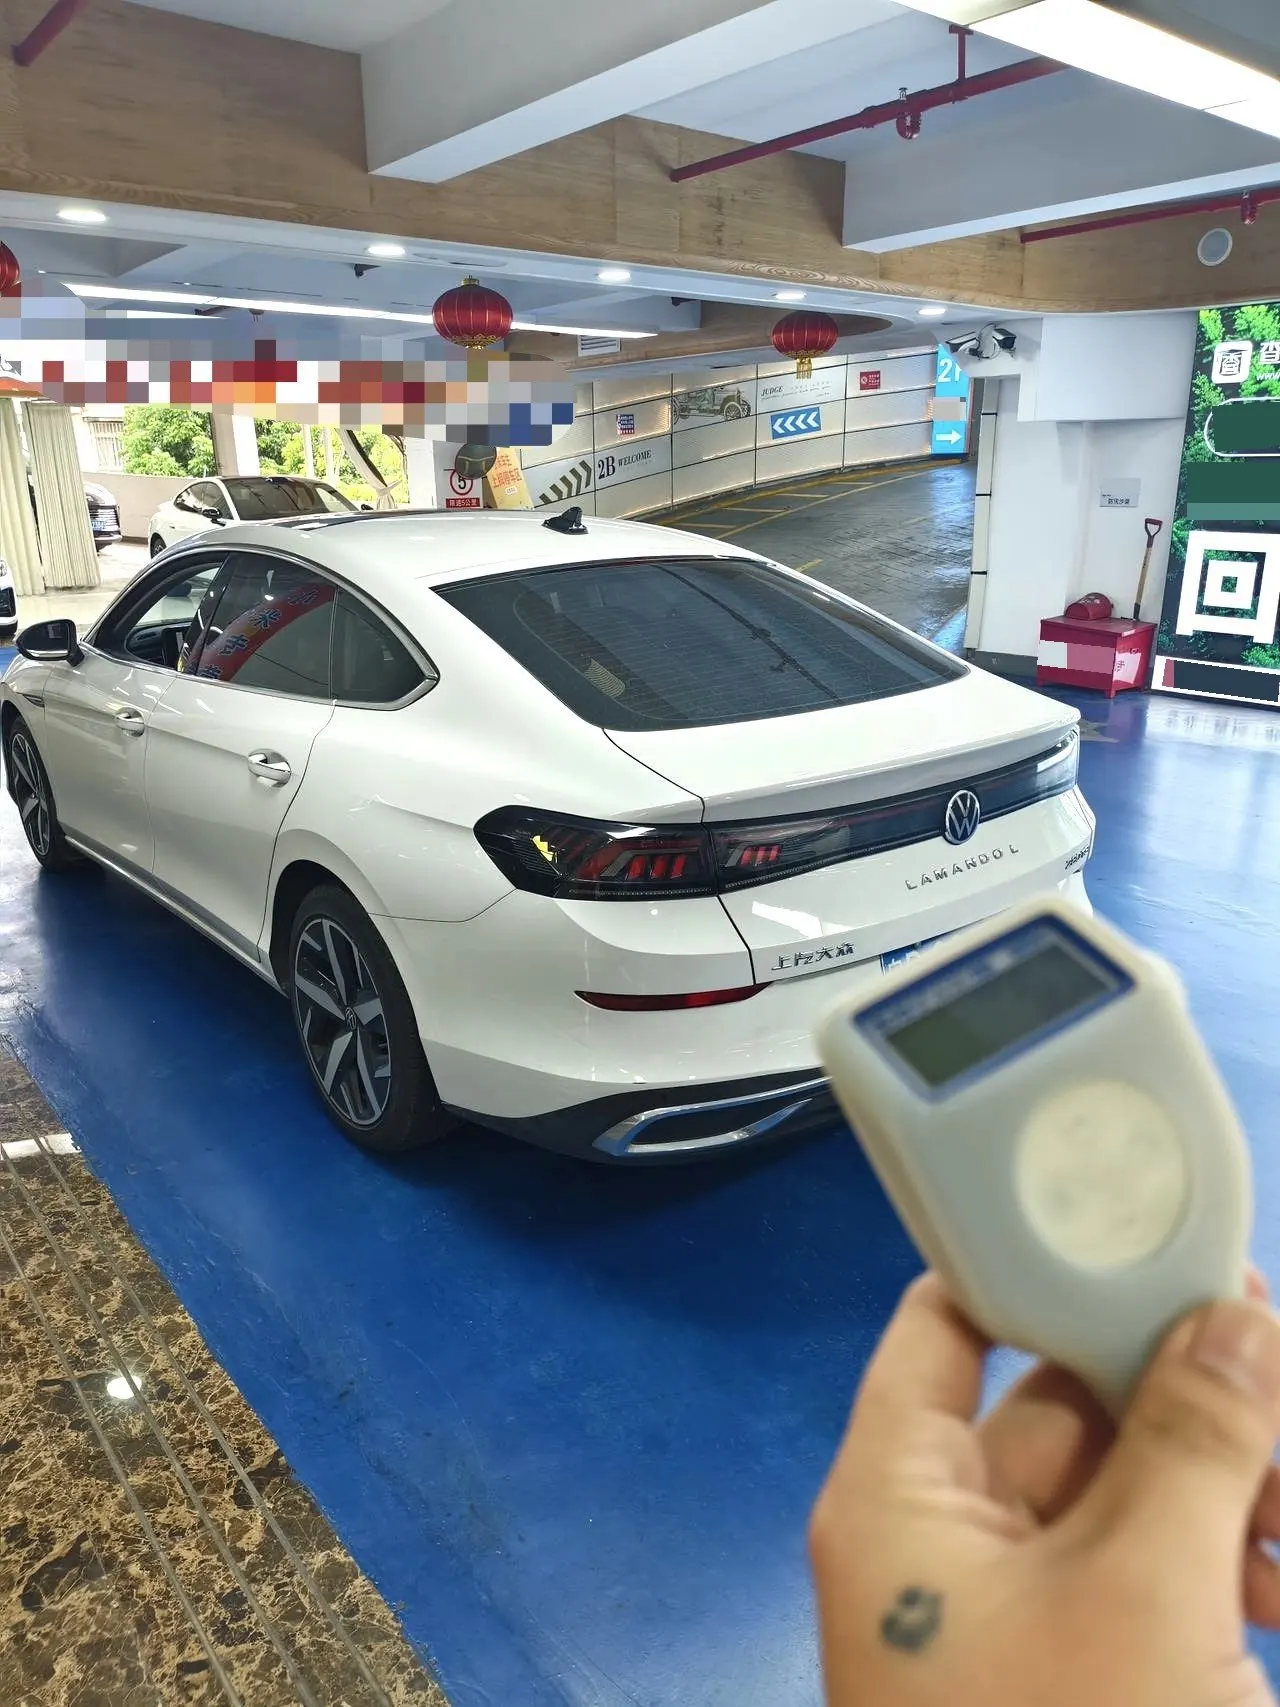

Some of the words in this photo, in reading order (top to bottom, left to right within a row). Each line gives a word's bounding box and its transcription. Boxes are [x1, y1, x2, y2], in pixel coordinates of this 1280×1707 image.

[598, 455, 616, 480] 2B
[617, 449, 652, 468] WELCOME
[457, 475, 466, 490] 5
[905, 848, 1003, 890] LAMANDO
[1008, 844, 1019, 854] L
[771, 942, 855, 971] 上汽大众
